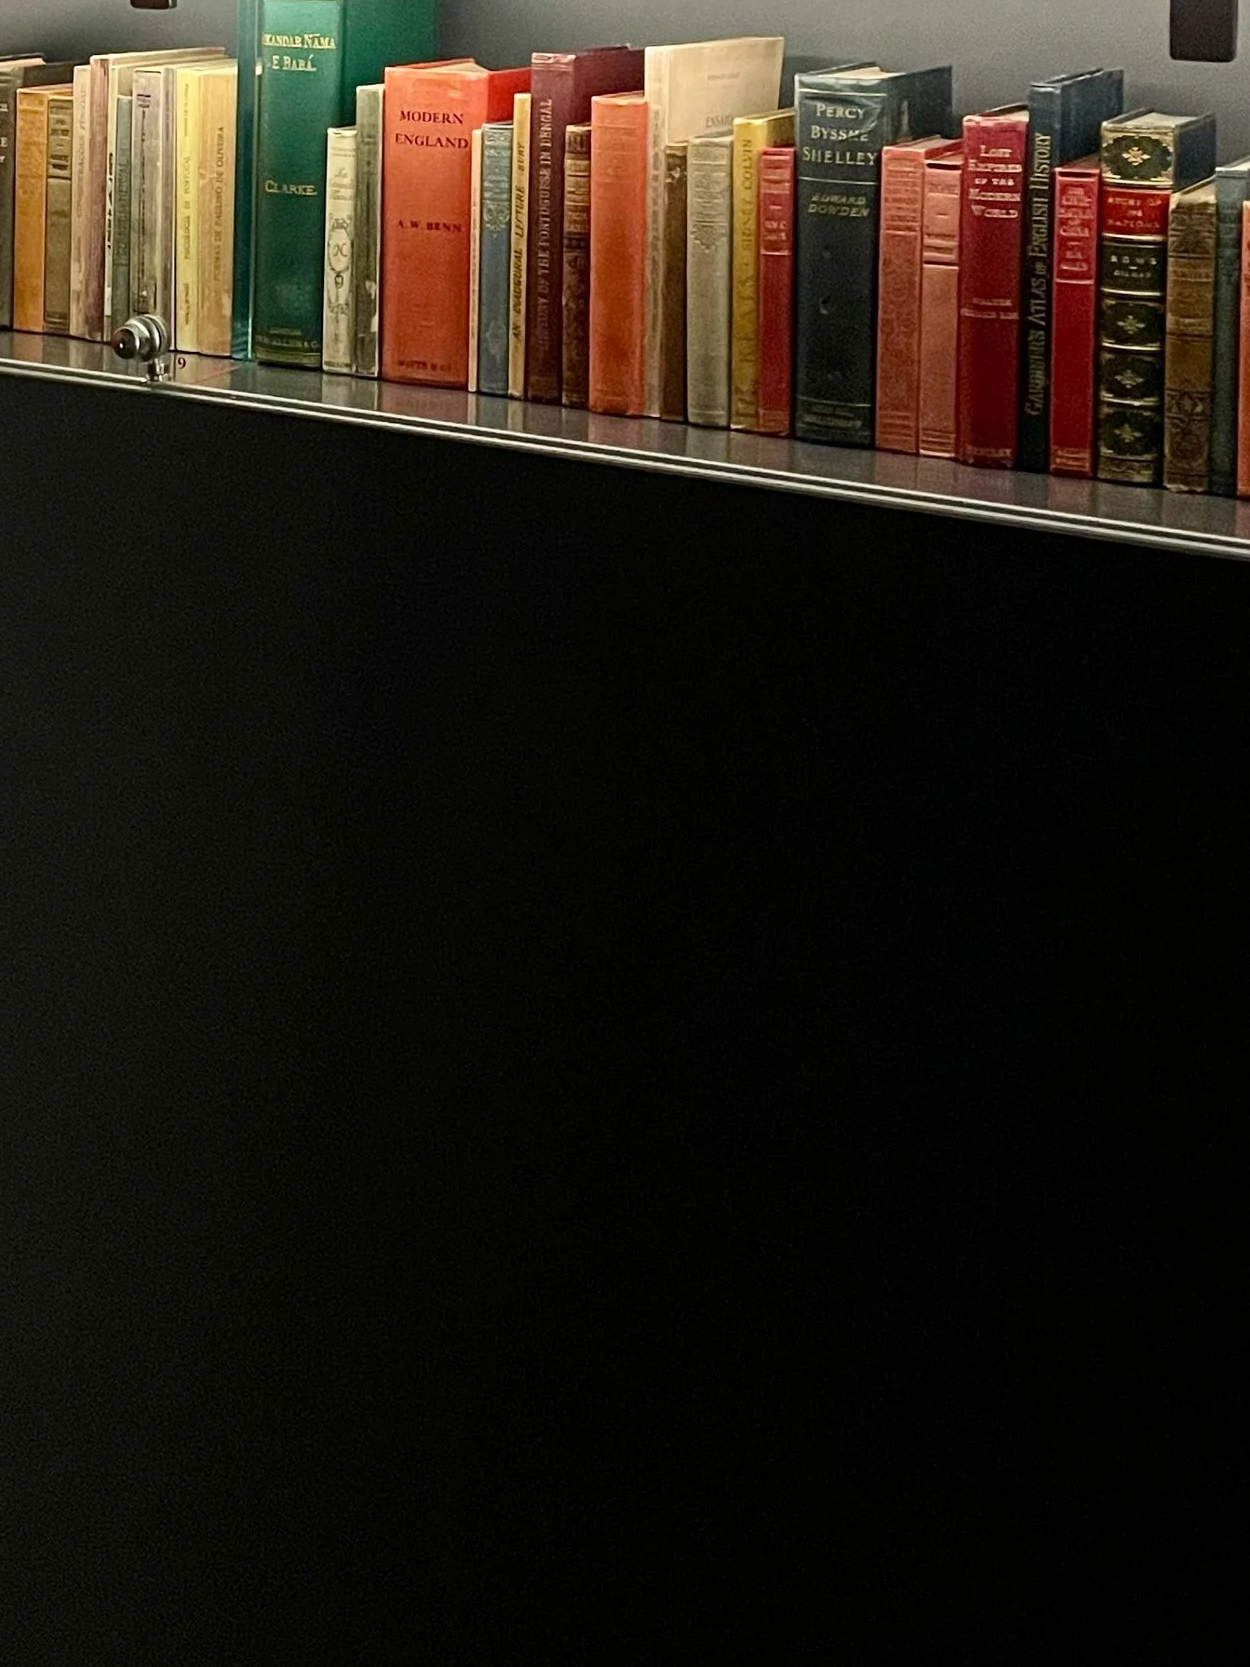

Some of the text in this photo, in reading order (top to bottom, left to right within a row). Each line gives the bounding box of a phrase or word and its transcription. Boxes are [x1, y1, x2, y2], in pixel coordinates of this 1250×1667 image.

[271, 55, 280, 69] E
[400, 110, 463, 124] MODERN
[816, 103, 865, 119] PERCY
[540, 98, 553, 147] BENGAL
[216, 126, 225, 168] OLIVEIRA
[395, 133, 469, 149] ENGLAND
[540, 152, 551, 165] IN
[802, 146, 879, 165] SHELLEY
[980, 145, 1013, 158] LOST
[742, 138, 752, 191] COLVIN
[1029, 133, 1050, 191] HISTORY
[216, 171, 224, 184] DE
[538, 168, 551, 246] PORTUGUESE
[811, 194, 867, 205] EDWARD
[808, 204, 870, 217] DOWDEN
[970, 204, 1019, 219] WORLD
[426, 222, 463, 233] BENN
[1028, 197, 1048, 258] ENGLISH
[214, 230, 223, 242] DE
[512, 142, 525, 342] AN INAUGURAL LECTURE BURY
[539, 250, 550, 275] THE
[1028, 278, 1046, 326] ATLAS
[178, 357, 186, 369] 9
